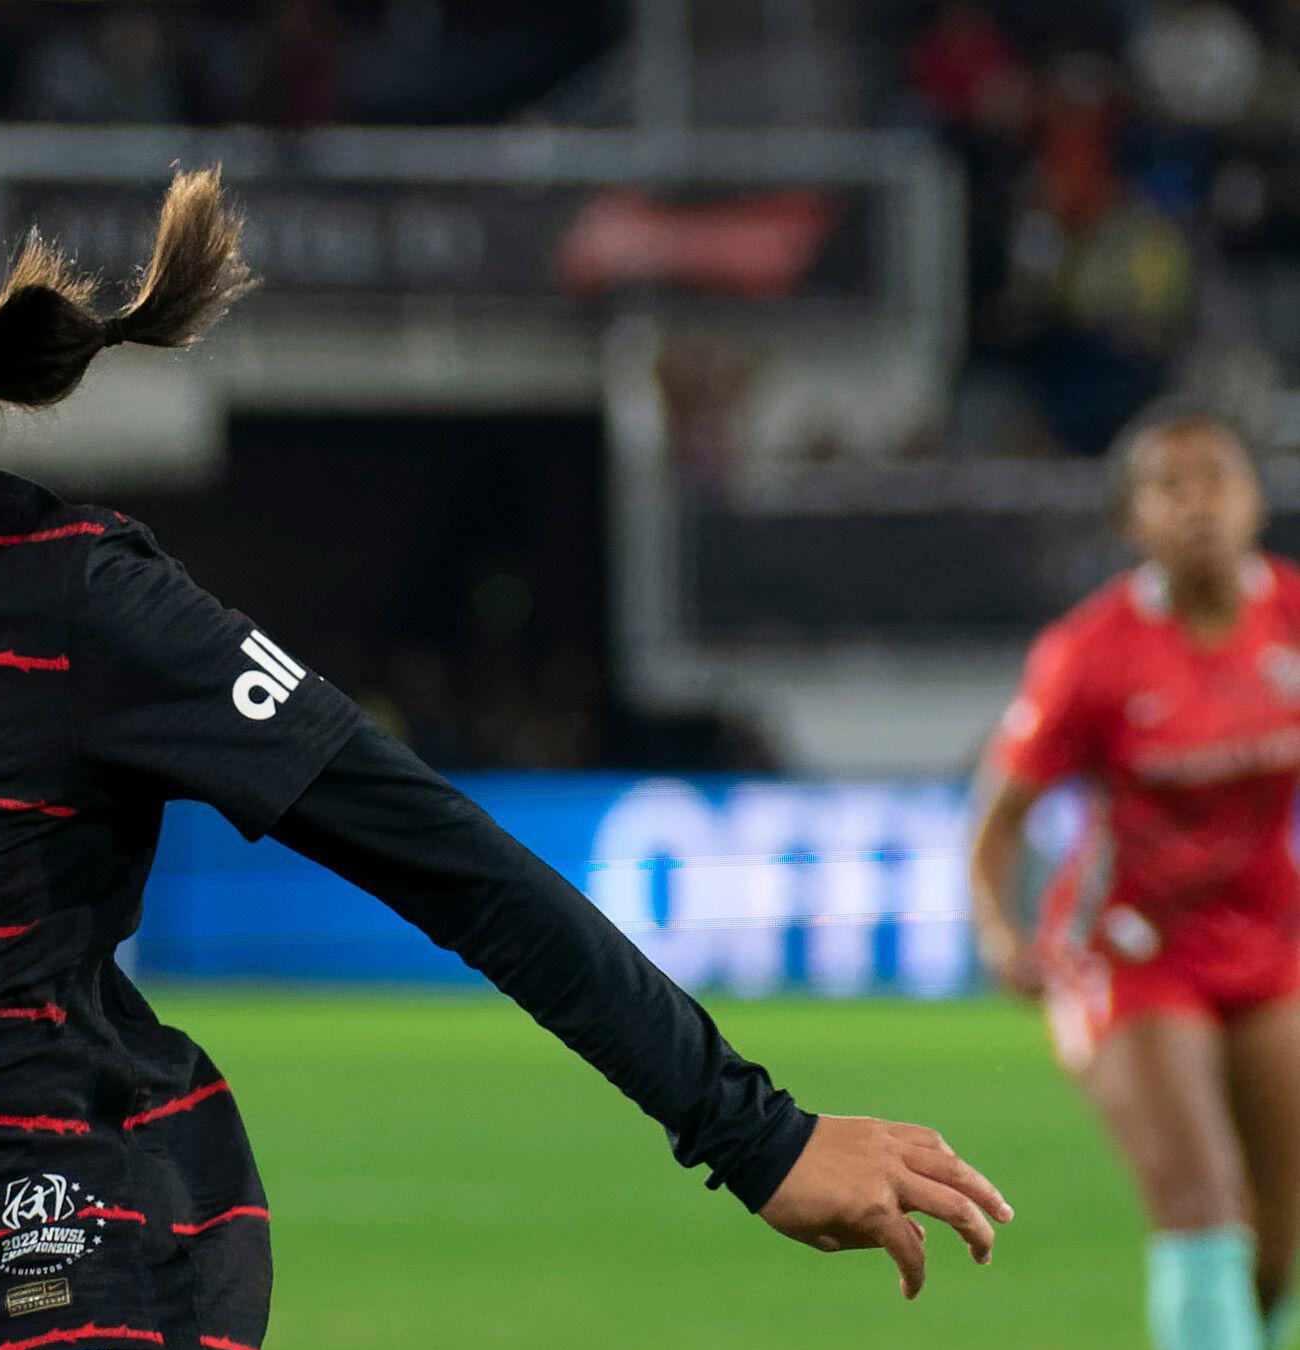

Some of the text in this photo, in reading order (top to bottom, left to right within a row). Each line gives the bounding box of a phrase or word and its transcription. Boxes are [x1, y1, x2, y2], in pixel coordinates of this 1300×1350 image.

[232, 629, 307, 720] all
[1, 1226, 86, 1251] 2022 NWSL
[1, 1241, 85, 1263] CHAMPIONSHIP
